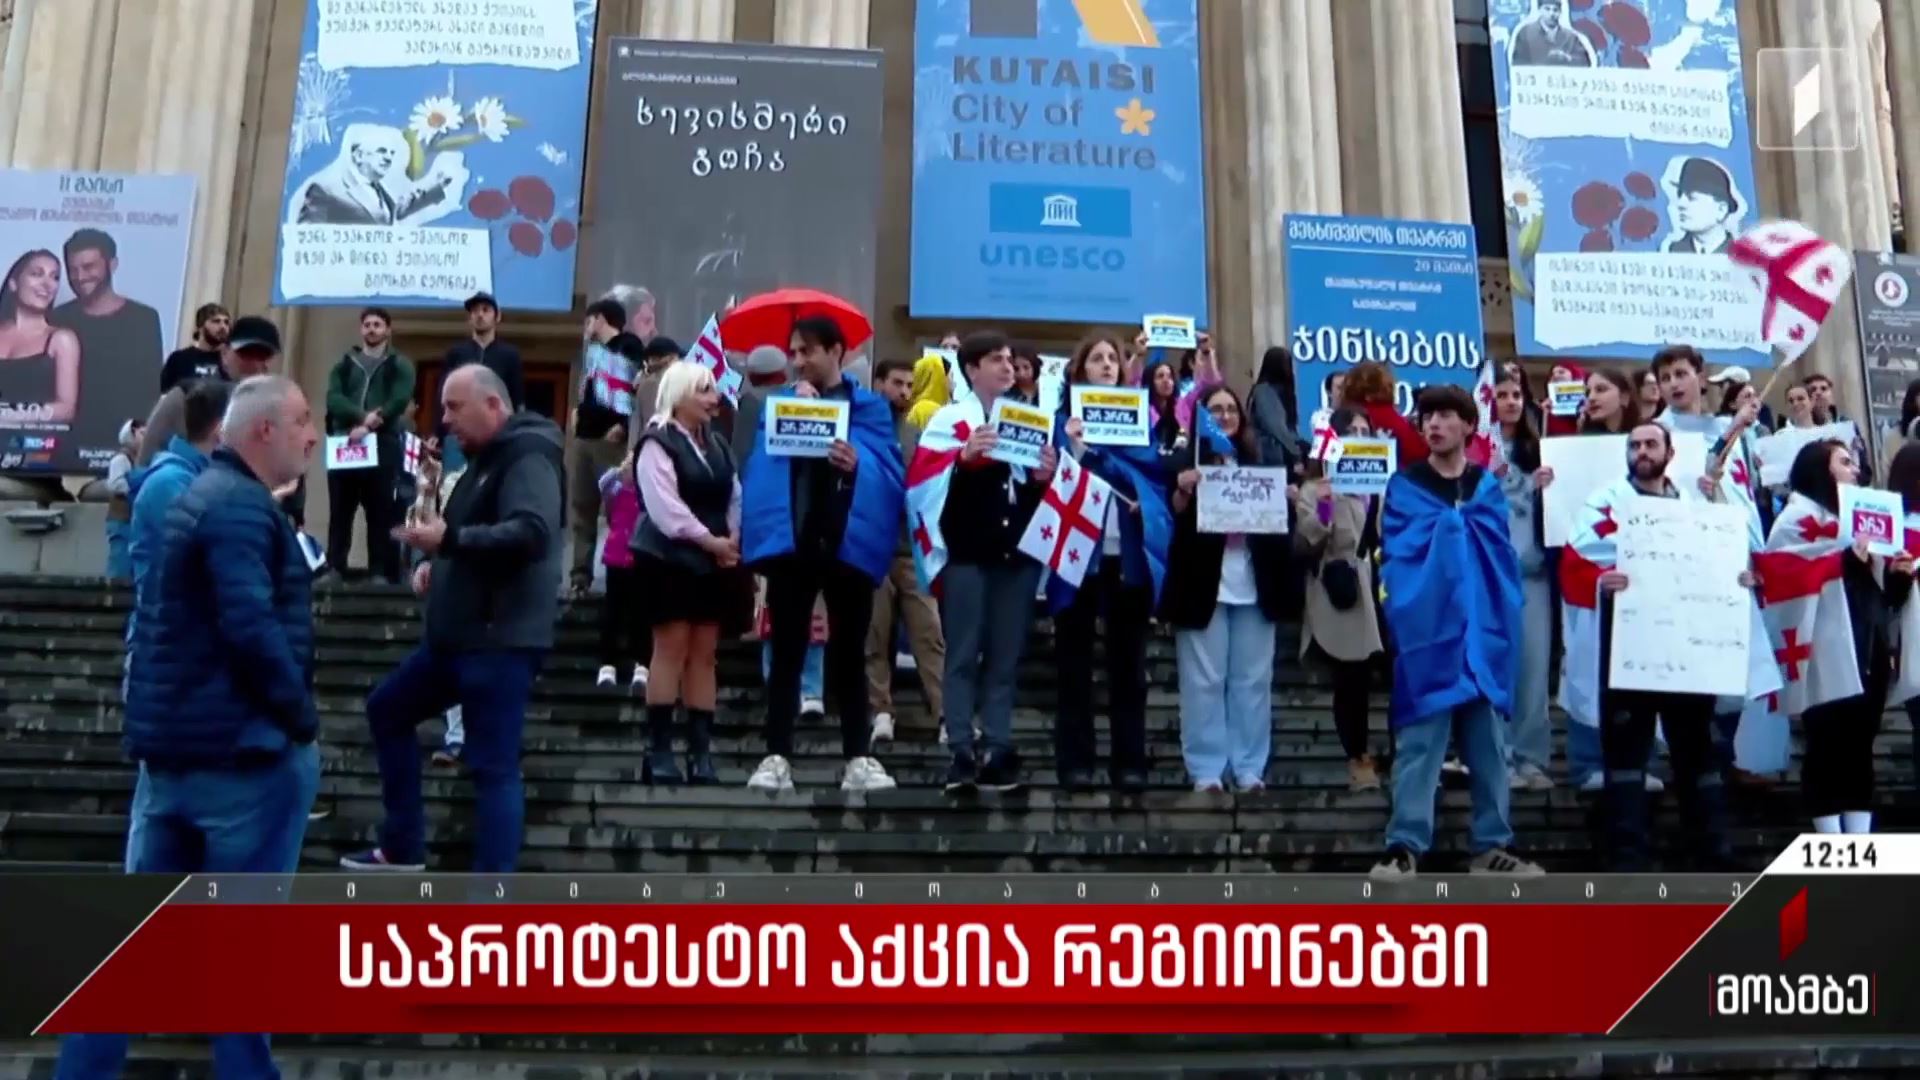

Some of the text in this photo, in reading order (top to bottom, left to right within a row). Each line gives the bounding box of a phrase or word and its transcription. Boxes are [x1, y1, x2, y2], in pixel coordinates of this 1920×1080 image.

[952, 55, 1155, 93] KUTAISI
[952, 93, 1084, 130] City of
[692, 142, 786, 177] გოჩა
[952, 132, 1156, 170] Literature
[1289, 220, 1394, 245] მესხიშვილის
[980, 243, 1125, 271] unesco
[1414, 259, 1430, 271] 20
[364, 273, 476, 290] გიორგი ლეონიძე
[1293, 324, 1481, 370] ჯინსების
[1858, 513, 1886, 535] არა
